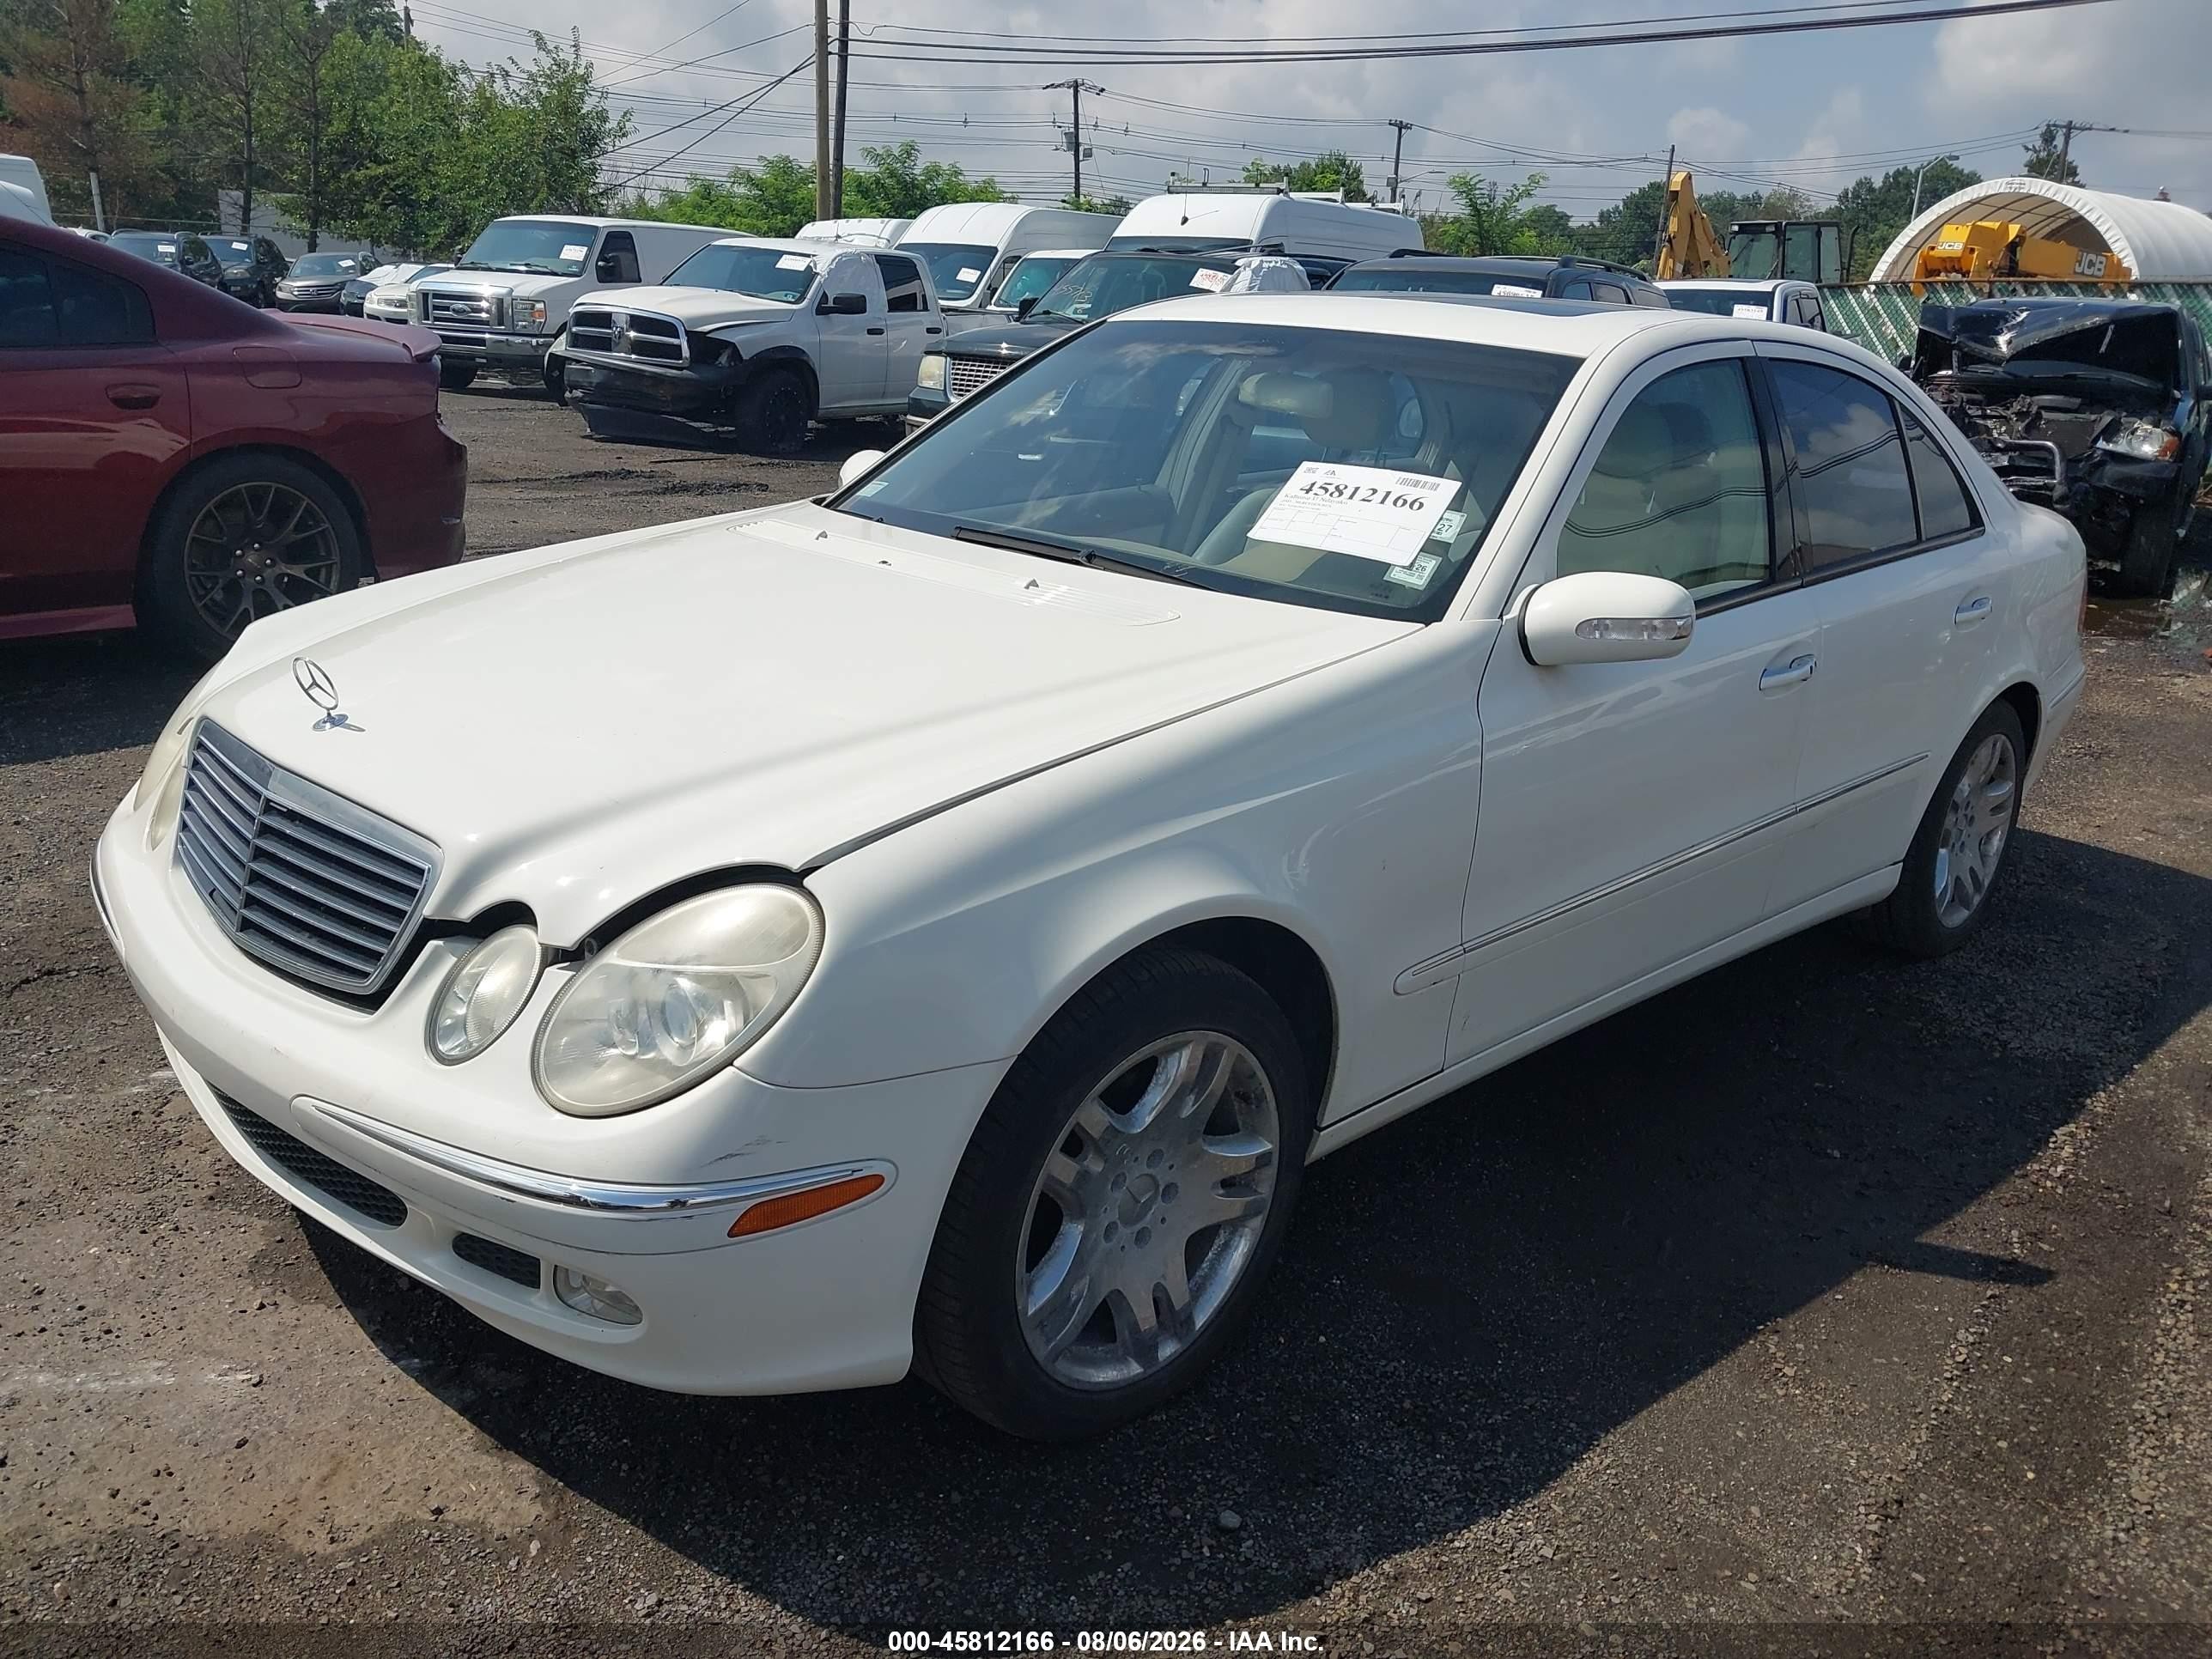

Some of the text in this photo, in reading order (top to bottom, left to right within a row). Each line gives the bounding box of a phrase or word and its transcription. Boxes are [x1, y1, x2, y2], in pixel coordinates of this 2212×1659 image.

[1937, 241, 1964, 250] JCB
[2075, 252, 2107, 276] JCB
[1299, 480, 1428, 511] 45812166
[1437, 523, 1453, 533] 27
[1415, 563, 1428, 572] 26
